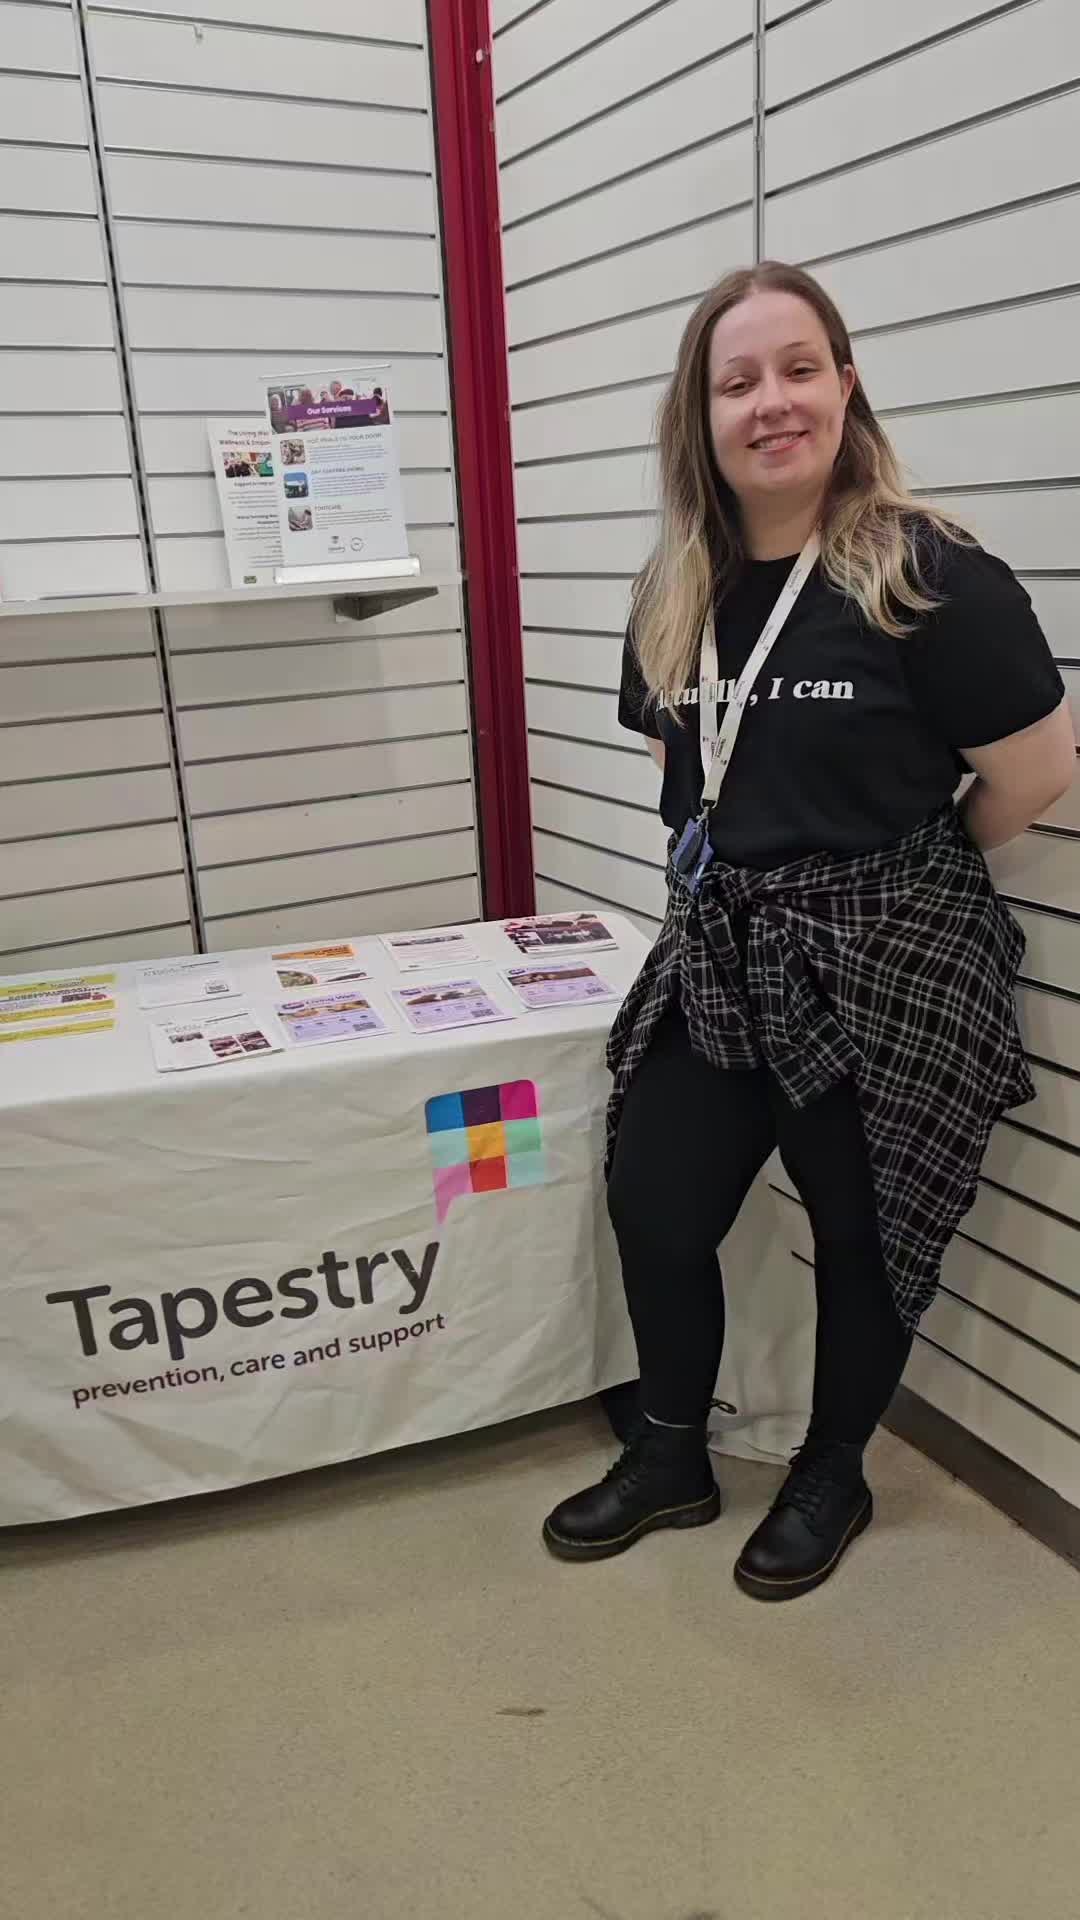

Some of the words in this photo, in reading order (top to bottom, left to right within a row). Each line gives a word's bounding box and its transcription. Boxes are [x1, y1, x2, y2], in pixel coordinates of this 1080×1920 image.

[306, 407, 320, 416] Our
[321, 405, 352, 414] Services
[768, 677, 784, 700] I
[793, 680, 854, 700] can
[46, 1241, 440, 1361] Tapestry
[73, 1366, 226, 1409] prevention,
[230, 1351, 286, 1378] care
[293, 1338, 342, 1368] and
[348, 1312, 447, 1354] support
